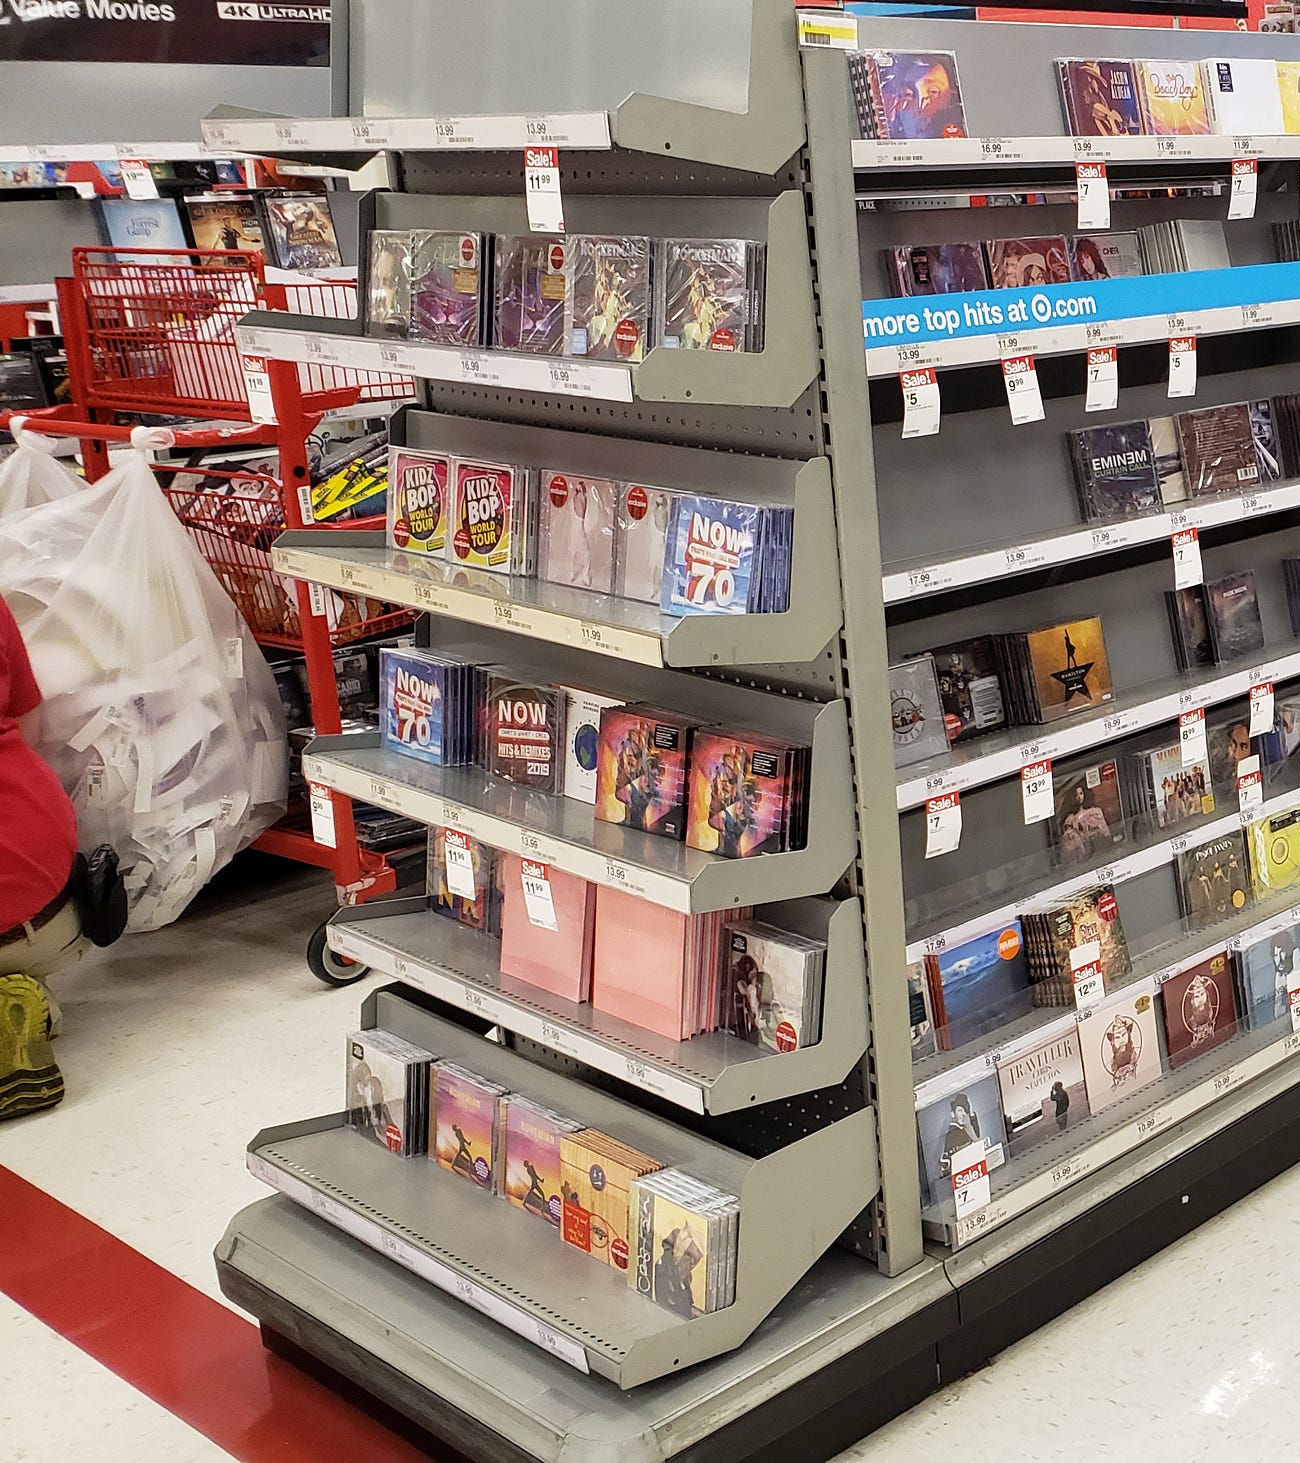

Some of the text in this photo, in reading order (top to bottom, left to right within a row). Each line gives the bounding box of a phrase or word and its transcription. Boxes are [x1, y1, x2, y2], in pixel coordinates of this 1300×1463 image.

[86, 0, 177, 22] Movies
[224, 5, 253, 18] 4K
[1110, 69, 1129, 86] JASON
[435, 124, 454, 137] 13.99
[526, 122, 547, 135] 13.99
[981, 143, 1002, 153] 16.99
[1073, 142, 1092, 152] 13.99
[1157, 141, 1174, 151] 11.99
[1233, 140, 1249, 151] 11.99
[526, 149, 554, 167] Sale!
[1078, 165, 1102, 178] Sale!
[1233, 162, 1255, 175] Sale!
[863, 313, 920, 339] more
[923, 307, 960, 335] top
[963, 301, 1004, 327] hits
[1008, 303, 1027, 323] at
[1241, 309, 1258, 320] 11.99
[1168, 318, 1185, 329] 13.99
[1086, 328, 1101, 338] 9.99
[998, 338, 1018, 349] 11.99
[1171, 338, 1193, 352] Sale!
[897, 350, 920, 361] 13.99
[1089, 349, 1114, 364] Sale!
[461, 360, 479, 373] 16.99
[1004, 358, 1031, 374] Sale!
[549, 370, 569, 383] 16.99
[902, 371, 932, 388] Sale!
[1092, 449, 1148, 472] EMINEM
[405, 465, 436, 488] KIDZ
[465, 475, 498, 501] KIDZ
[406, 484, 437, 512] BOP
[1242, 499, 1258, 511] 13.99
[409, 506, 434, 522] WORLD
[467, 497, 500, 526] BOP
[409, 518, 435, 534] TOUR
[1170, 514, 1188, 526] 10.99
[469, 520, 496, 536] WORLD
[692, 511, 743, 554] NOW
[470, 530, 497, 547] TOUR
[1092, 532, 1110, 544] 17.99
[1173, 531, 1195, 546] Sale!
[1005, 551, 1025, 563] 13.99
[687, 563, 735, 607] 70
[908, 573, 931, 587] 17.99
[414, 587, 431, 599] 13.99
[494, 605, 512, 619] 13.99
[581, 627, 601, 641] 11.99
[396, 667, 434, 703] NOW
[1250, 684, 1271, 699] Sale!
[1179, 694, 1193, 705] 9.99
[498, 699, 547, 726] NOW
[1180, 711, 1202, 727] Sale!
[397, 711, 431, 747] 70
[1103, 717, 1122, 731] 18.99
[498, 742, 551, 761] HITS & REMIXES
[1020, 745, 1040, 758] 19.99
[527, 762, 550, 776] 2019
[1023, 762, 1048, 780] Sale!
[926, 777, 943, 790] 9.99
[1239, 774, 1259, 790] Sale!
[310, 783, 330, 798] Sale!
[927, 795, 956, 813] Sale!
[442, 808, 459, 821] 13.99
[1239, 811, 1254, 825] 13.99
[445, 830, 466, 848] Sale!
[521, 835, 539, 849] 13.99
[1171, 839, 1187, 852] 13.99
[521, 860, 545, 879] Sale!
[606, 865, 626, 880] 13.99
[1096, 869, 1115, 882] 10.99
[925, 938, 946, 953] 17.99
[1074, 962, 1098, 983] Sale!
[1153, 973, 1171, 987] 13.99
[1074, 1010, 1093, 1024] 15.99
[1283, 1036, 1299, 1051] 13.99
[985, 1053, 1001, 1067] 9.99
[1008, 1038, 1074, 1087] TRAVELLER
[626, 1063, 645, 1078] 13.99
[1031, 1064, 1053, 1080] CHRIS
[1025, 1068, 1061, 1093] STAPLETON
[1212, 1075, 1231, 1091] 10.99
[1137, 1118, 1156, 1134] 10.99
[955, 1164, 985, 1188] Sale!
[1051, 1165, 1072, 1183] 13.99
[965, 1213, 987, 1232] 13.99
